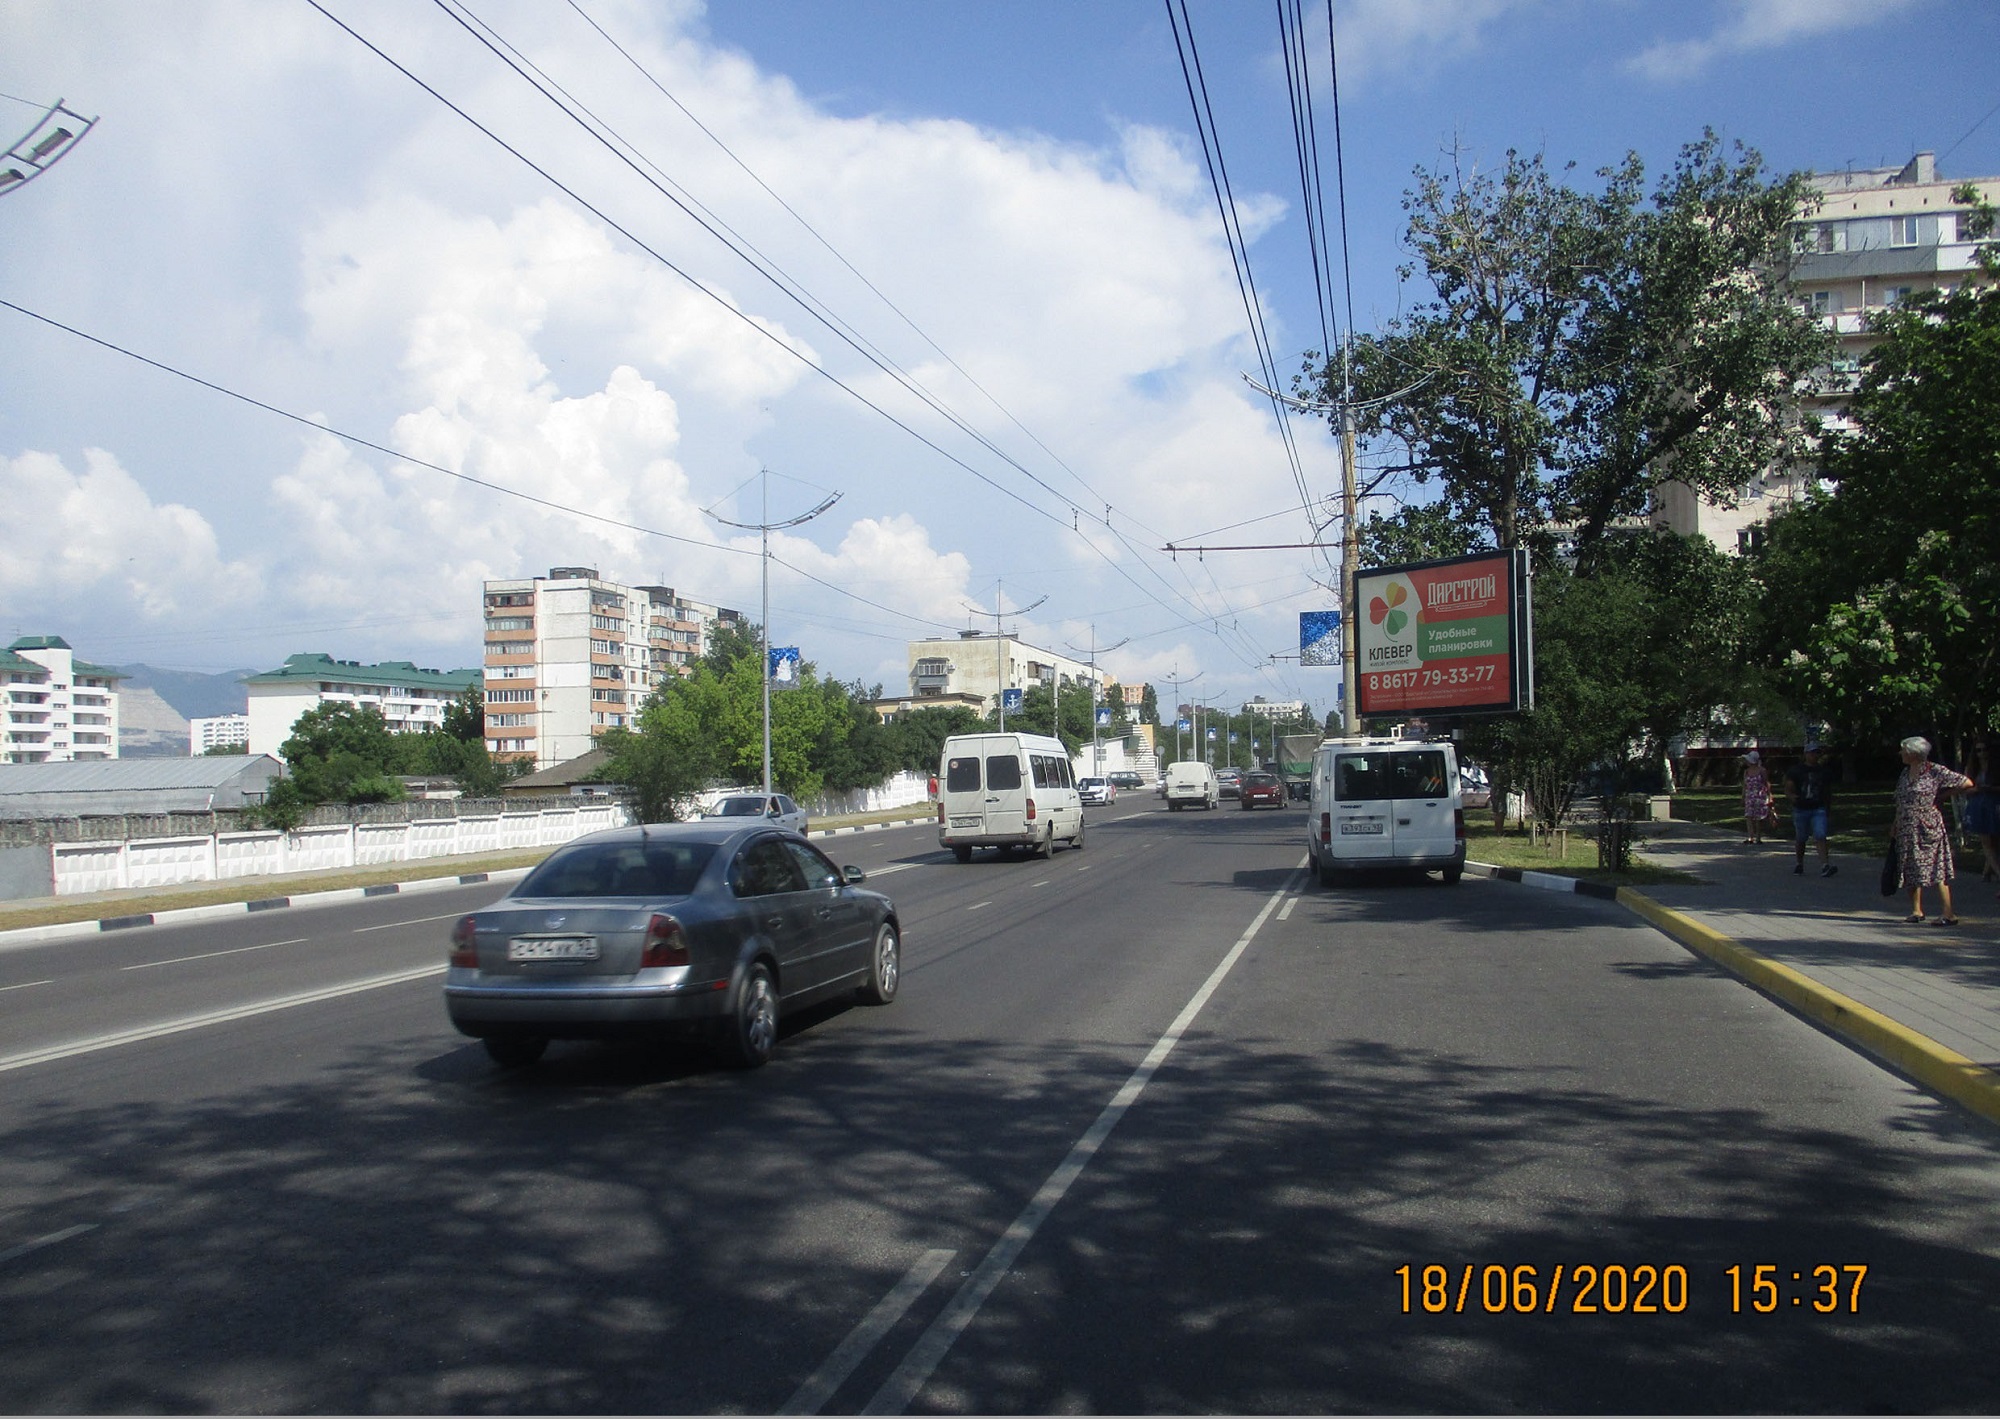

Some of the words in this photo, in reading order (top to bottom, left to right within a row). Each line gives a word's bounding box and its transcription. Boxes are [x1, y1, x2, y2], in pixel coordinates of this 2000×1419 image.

[1427, 574, 1496, 606] ДАРСТРОЙ
[1428, 627, 1477, 641] Удобные
[1369, 644, 1413, 661] КЛЕВЕР
[1428, 639, 1493, 653] планировки
[1369, 675, 1379, 690] 8
[1382, 672, 1418, 689] 8617
[1422, 665, 1495, 686] 79-33-77
